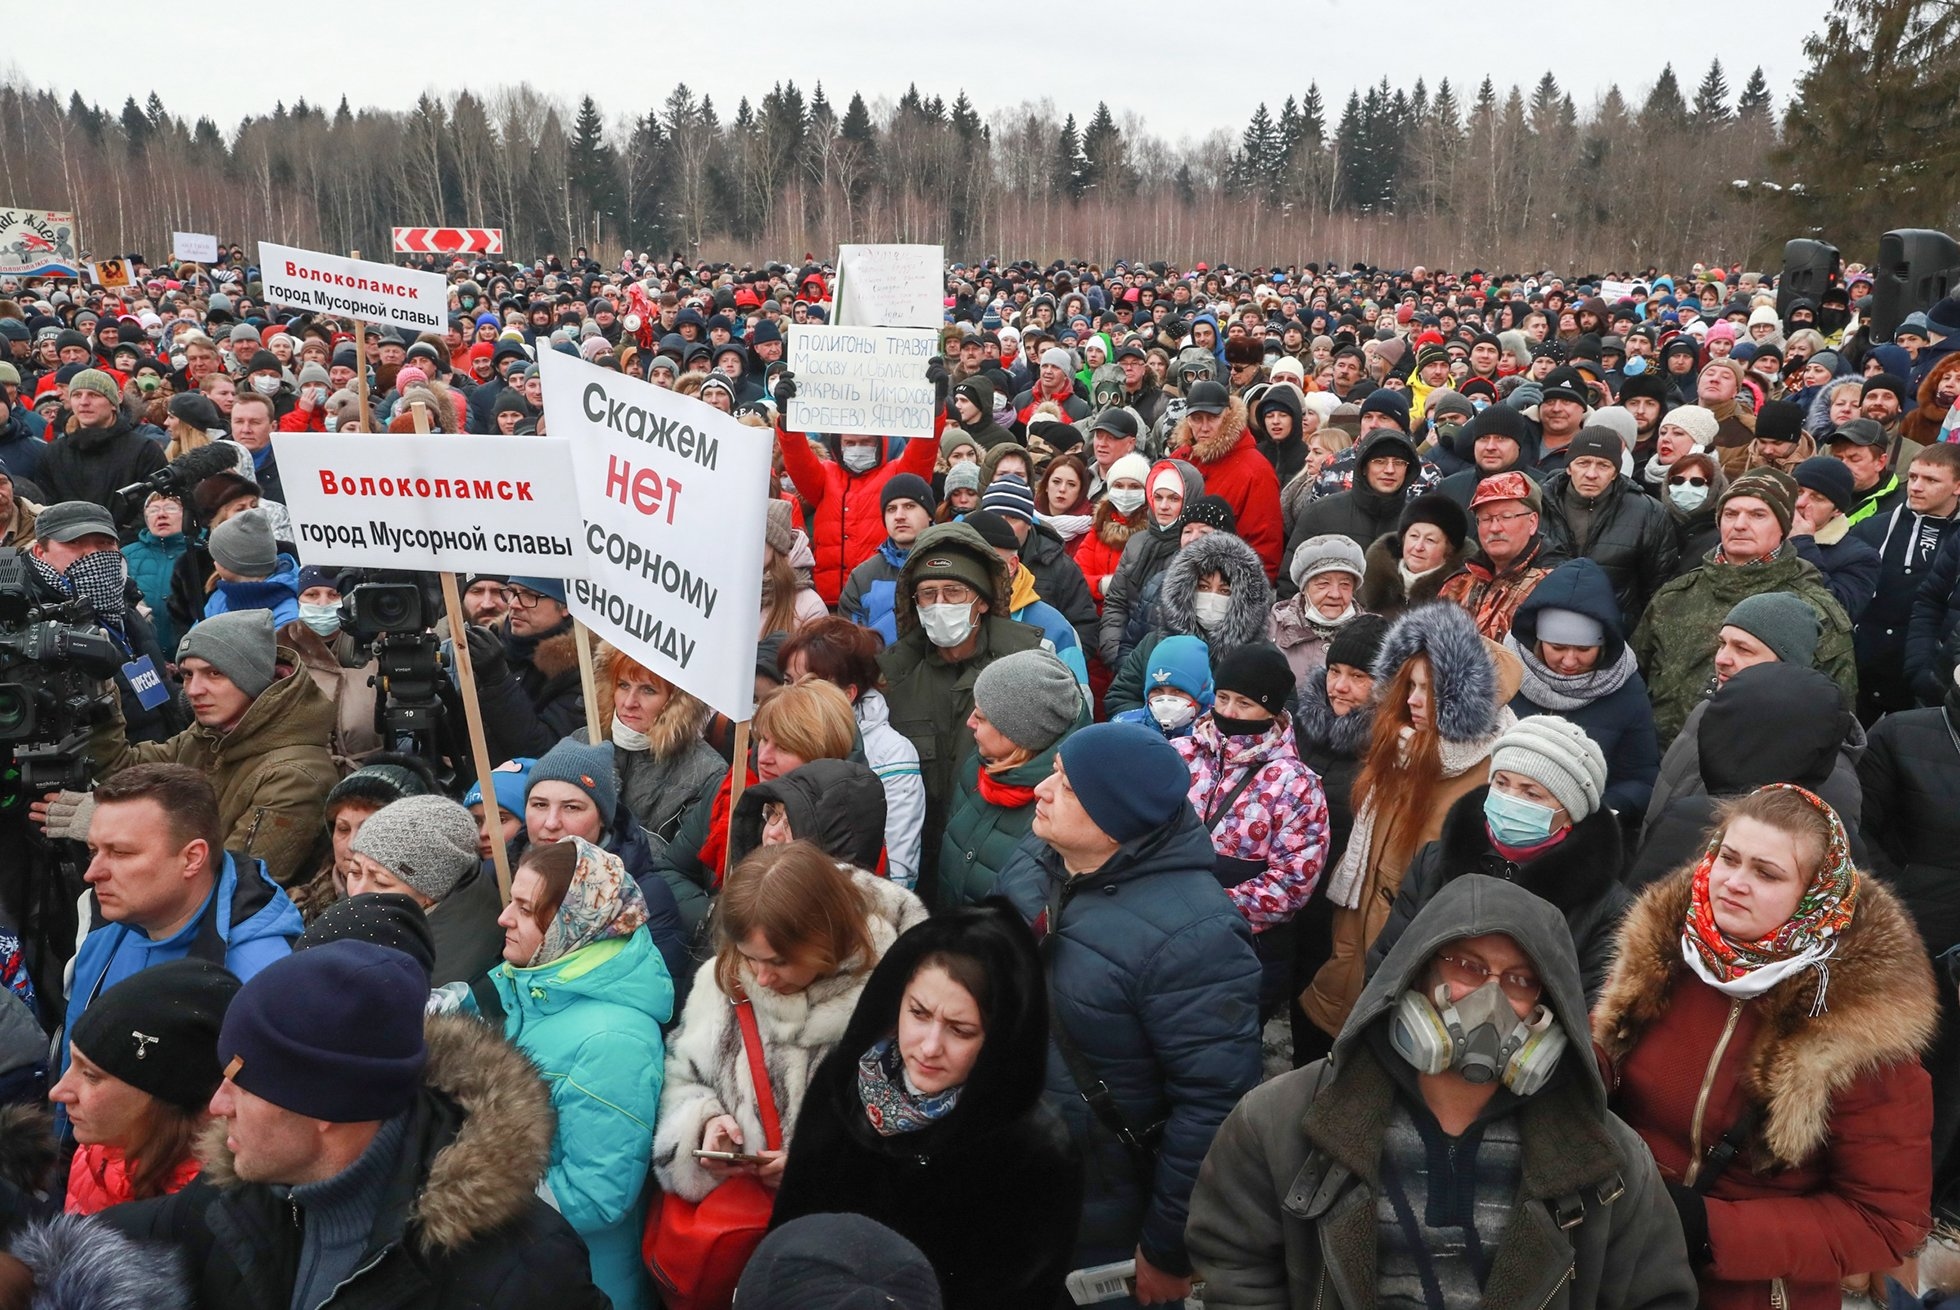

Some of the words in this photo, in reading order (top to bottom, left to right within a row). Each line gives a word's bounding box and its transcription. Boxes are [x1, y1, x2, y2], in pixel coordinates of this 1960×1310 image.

[285, 261, 418, 299] Волоколамск
[269, 284, 311, 305] город
[314, 290, 387, 317] Мусорной
[391, 308, 439, 326] славы
[799, 334, 876, 354] ПОЛИГОНЫ
[886, 337, 938, 356] ТРАВЯТ
[795, 381, 860, 401] ЗАКРЫТЬ
[583, 382, 719, 471] Скажем
[319, 470, 534, 501] Волоколамск
[300, 522, 367, 549] город
[369, 520, 487, 554] Мусорной
[493, 533, 573, 556] славы
[1920, 524, 1940, 550] NIKE
[583, 519, 718, 620] сорному
[131, 669, 161, 693] ПРЕССА
[404, 710, 414, 718] 10
